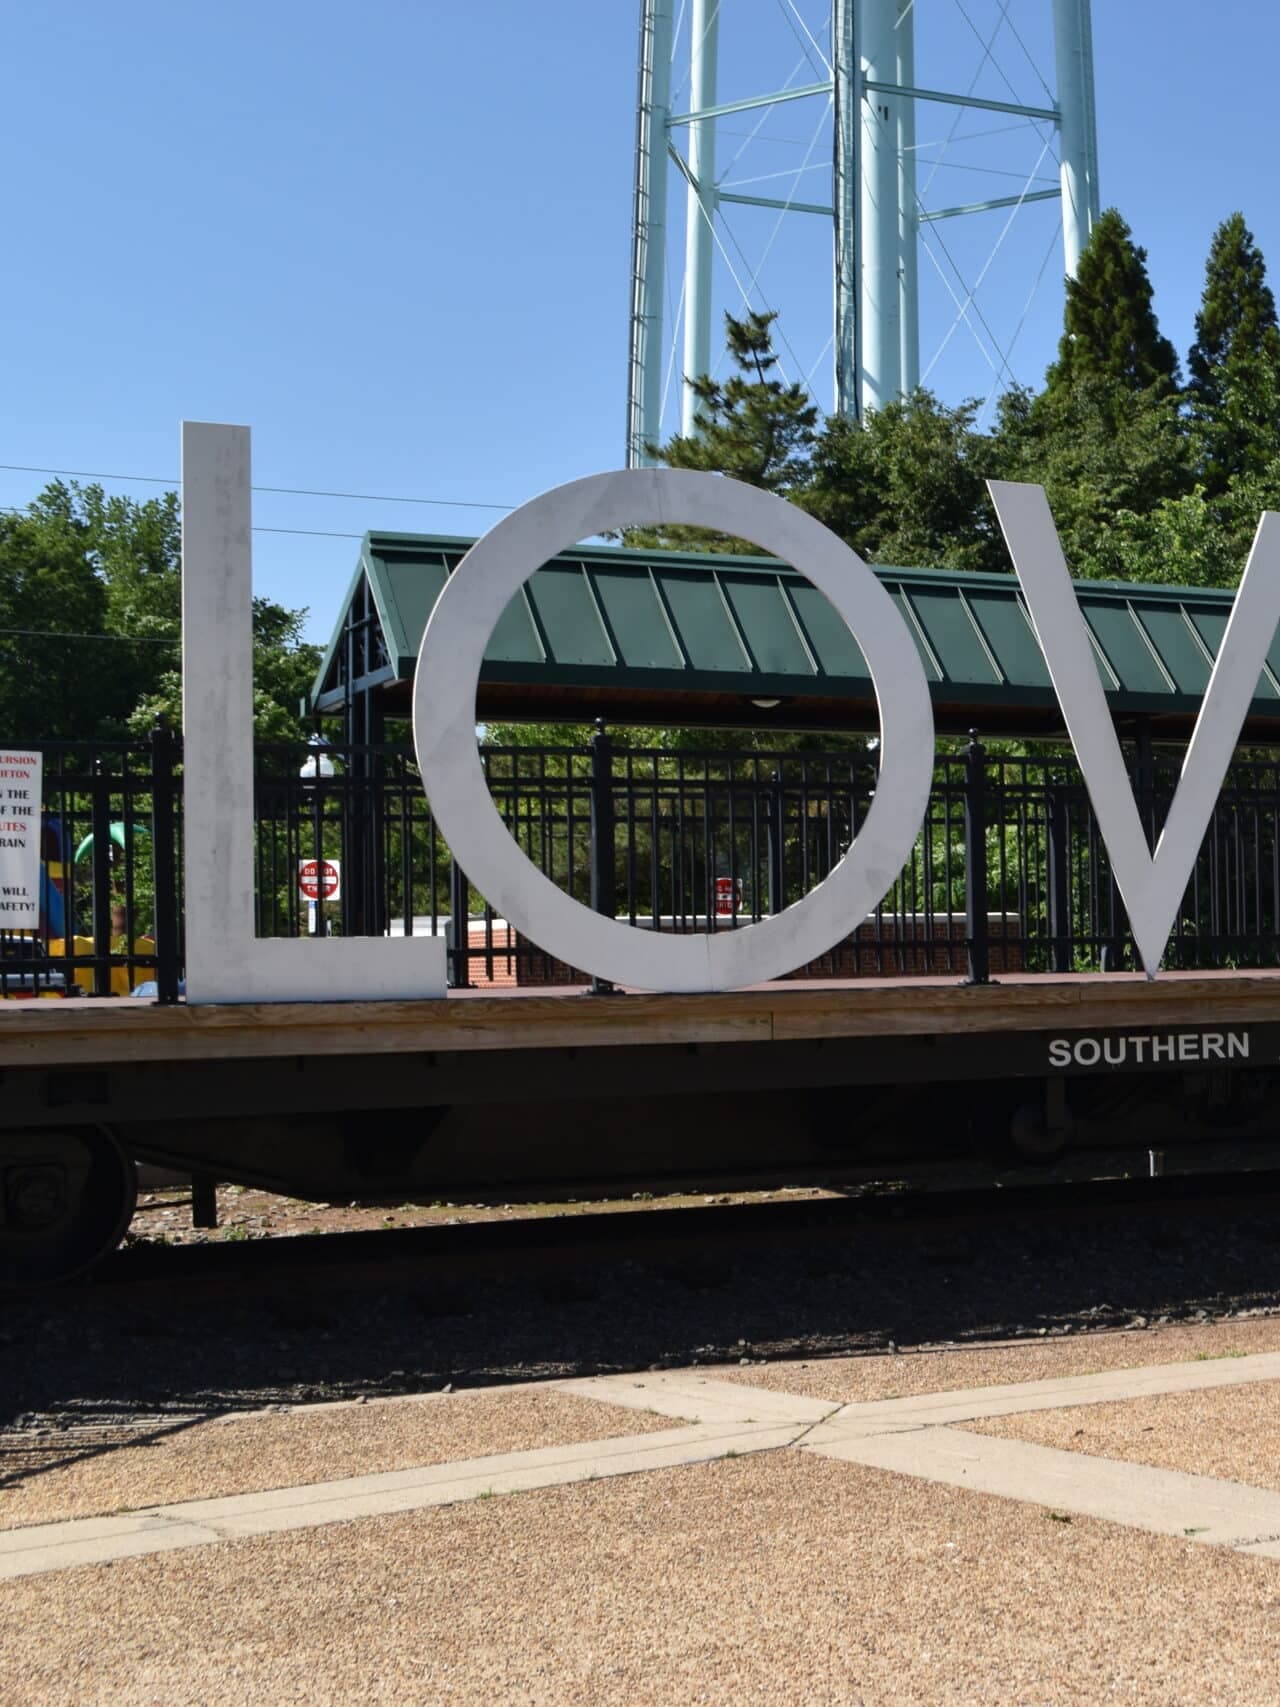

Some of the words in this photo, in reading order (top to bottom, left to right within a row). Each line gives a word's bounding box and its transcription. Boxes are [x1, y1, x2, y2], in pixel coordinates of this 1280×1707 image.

[8, 789, 30, 799] THE
[11, 806, 35, 816] THE
[2, 887, 29, 896] WILL
[1048, 1031, 1250, 1067] SOUTHERN
